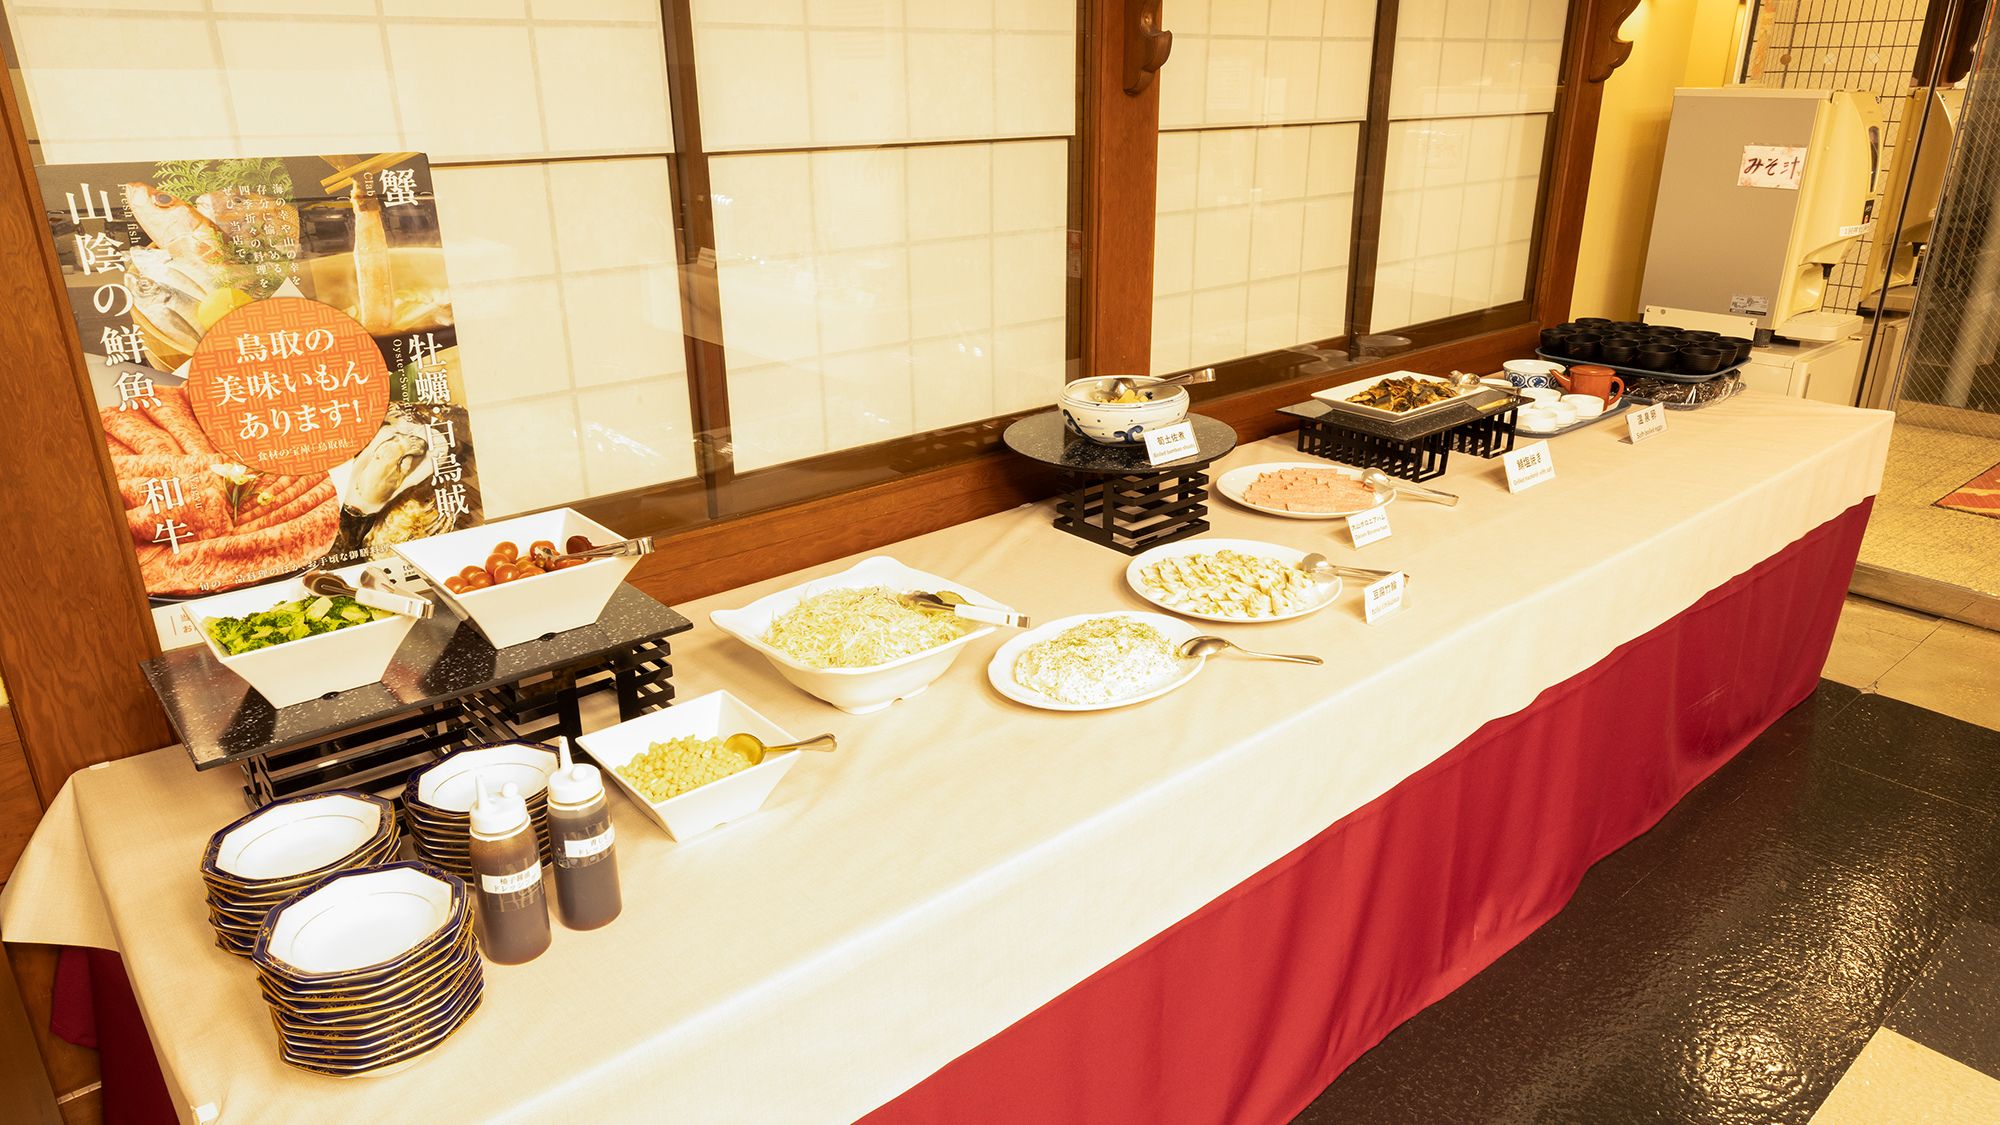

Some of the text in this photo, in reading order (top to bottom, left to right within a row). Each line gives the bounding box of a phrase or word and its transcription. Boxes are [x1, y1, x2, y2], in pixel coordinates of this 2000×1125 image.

[379, 168, 418, 208] 蟹
[1744, 156, 1800, 179] みそ汁
[117, 183, 142, 247] Fresh fish
[238, 185, 268, 288] 四季折々の料理を
[272, 183, 301, 286] 海の幸や山の幸を
[66, 183, 161, 412] 山陰の鮮魚
[237, 329, 334, 363] 鳥取の
[210, 361, 370, 407] 美味いもん
[1156, 431, 1185, 445] 筍土佐煮
[139, 477, 194, 555] 和牛
[1373, 580, 1398, 600] 豆腐竹輪
